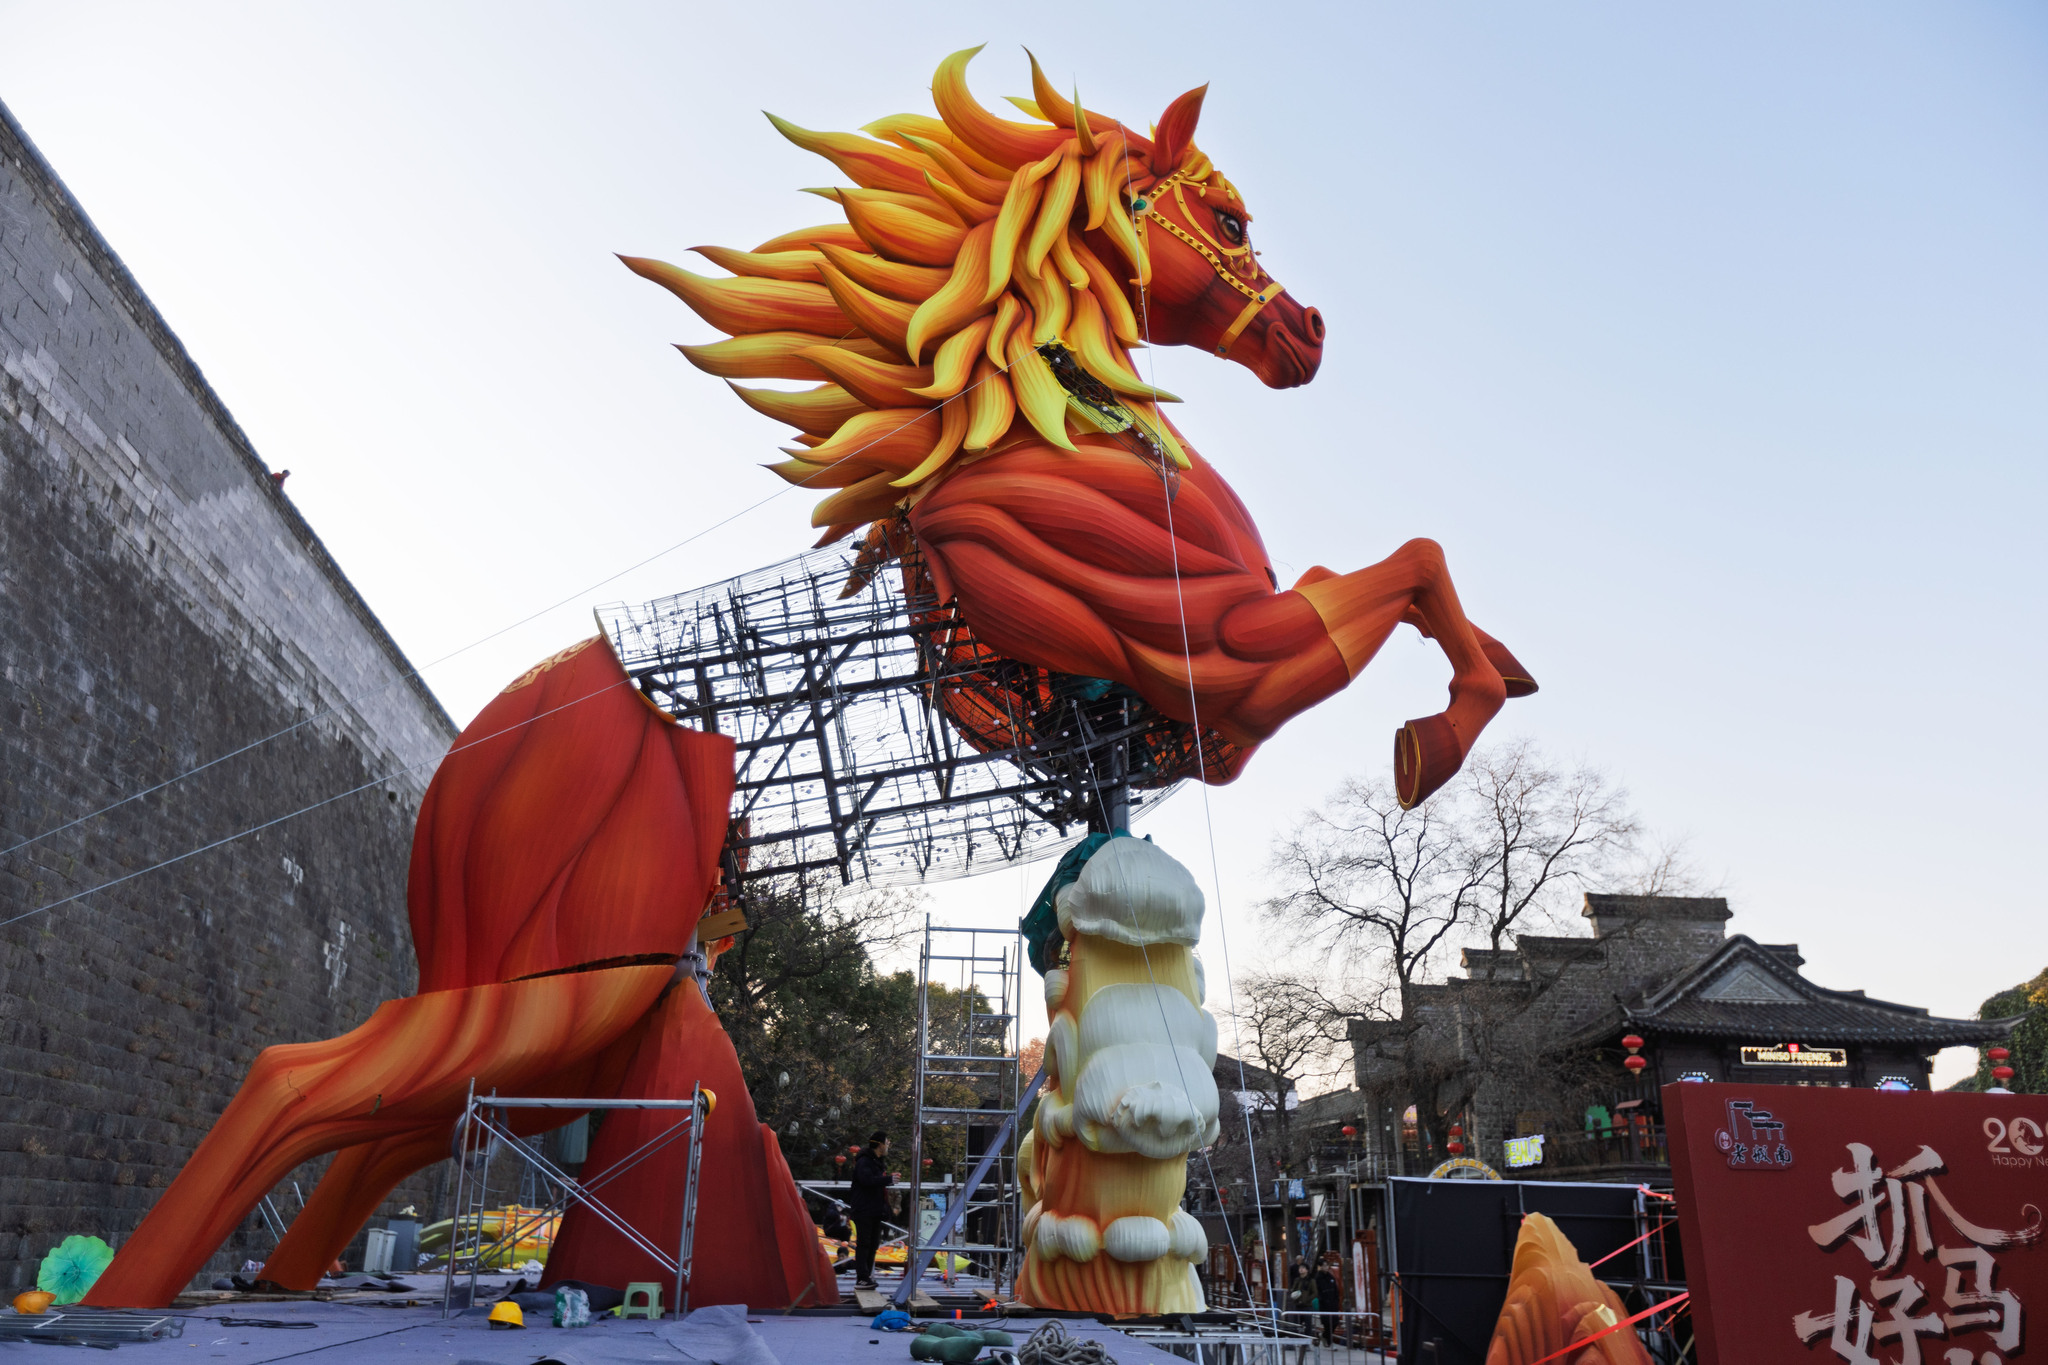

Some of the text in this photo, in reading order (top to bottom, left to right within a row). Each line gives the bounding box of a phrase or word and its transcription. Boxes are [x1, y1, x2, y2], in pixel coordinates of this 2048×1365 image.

[1757, 1051, 1832, 1061] MINISO FRIENDS
[1983, 1117, 2048, 1155] 20
[1503, 1134, 1545, 1167] PEANUTS
[1992, 1154, 2032, 1168] Happy
